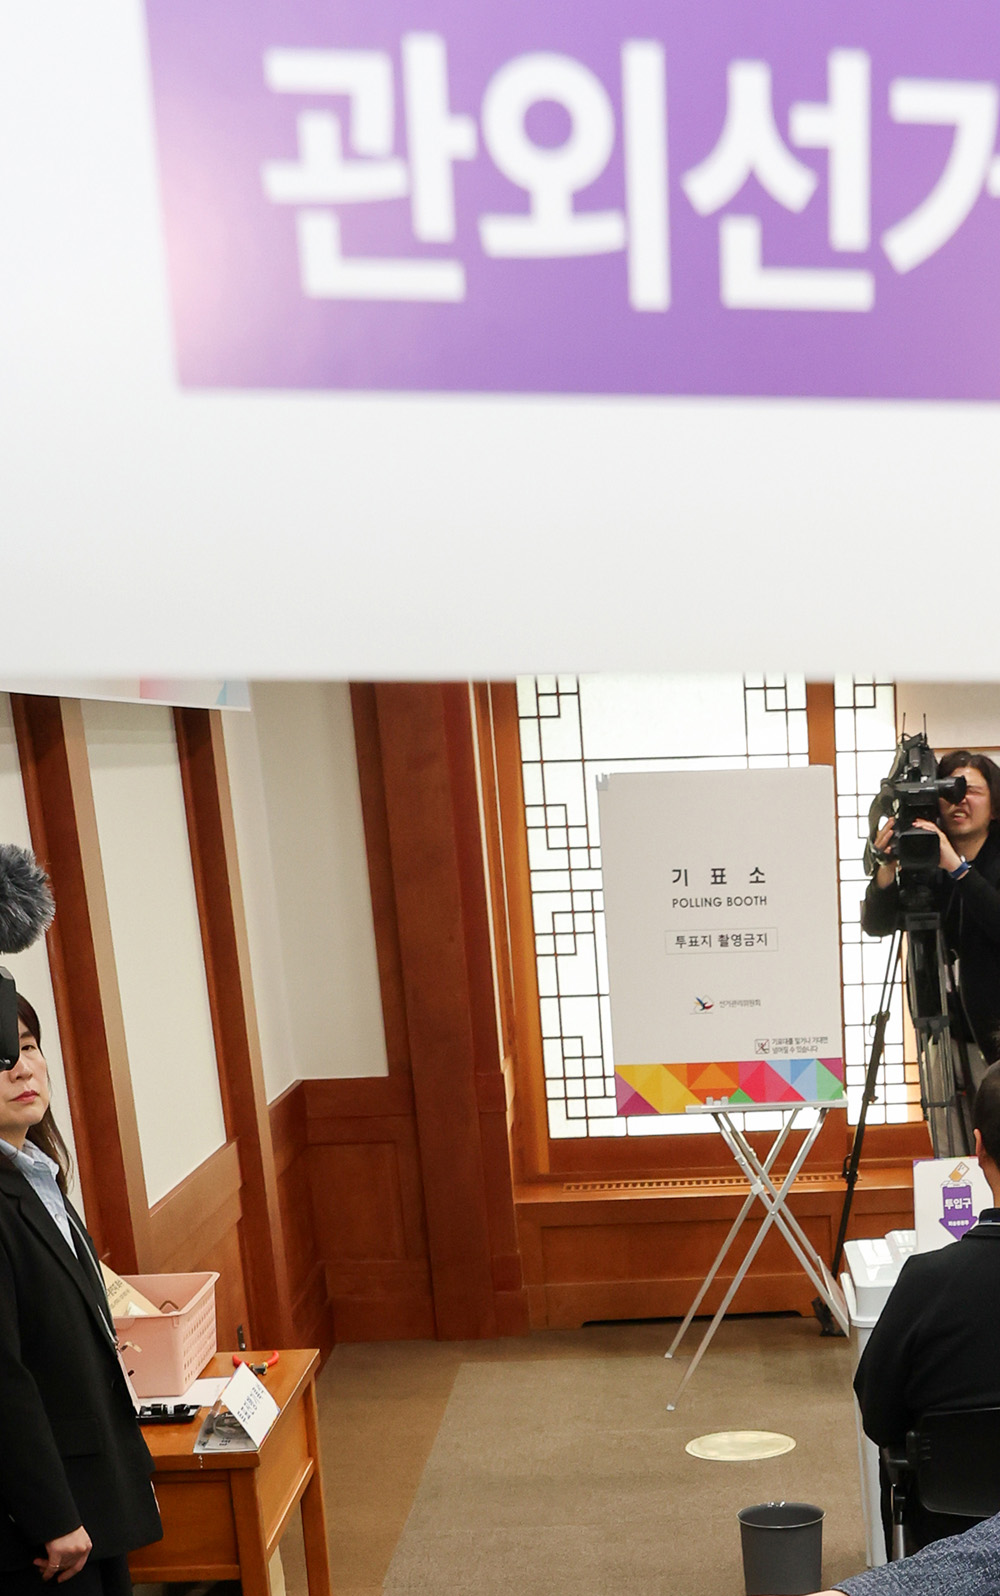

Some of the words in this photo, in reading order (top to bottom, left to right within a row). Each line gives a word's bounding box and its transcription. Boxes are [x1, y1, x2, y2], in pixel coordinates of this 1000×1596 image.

[672, 897, 722, 909] POLLING
[726, 896, 768, 907] BOOTH
[675, 935, 712, 949] 투표지
[718, 933, 768, 948] 촬영금지
[945, 1198, 971, 1210] 투입구
